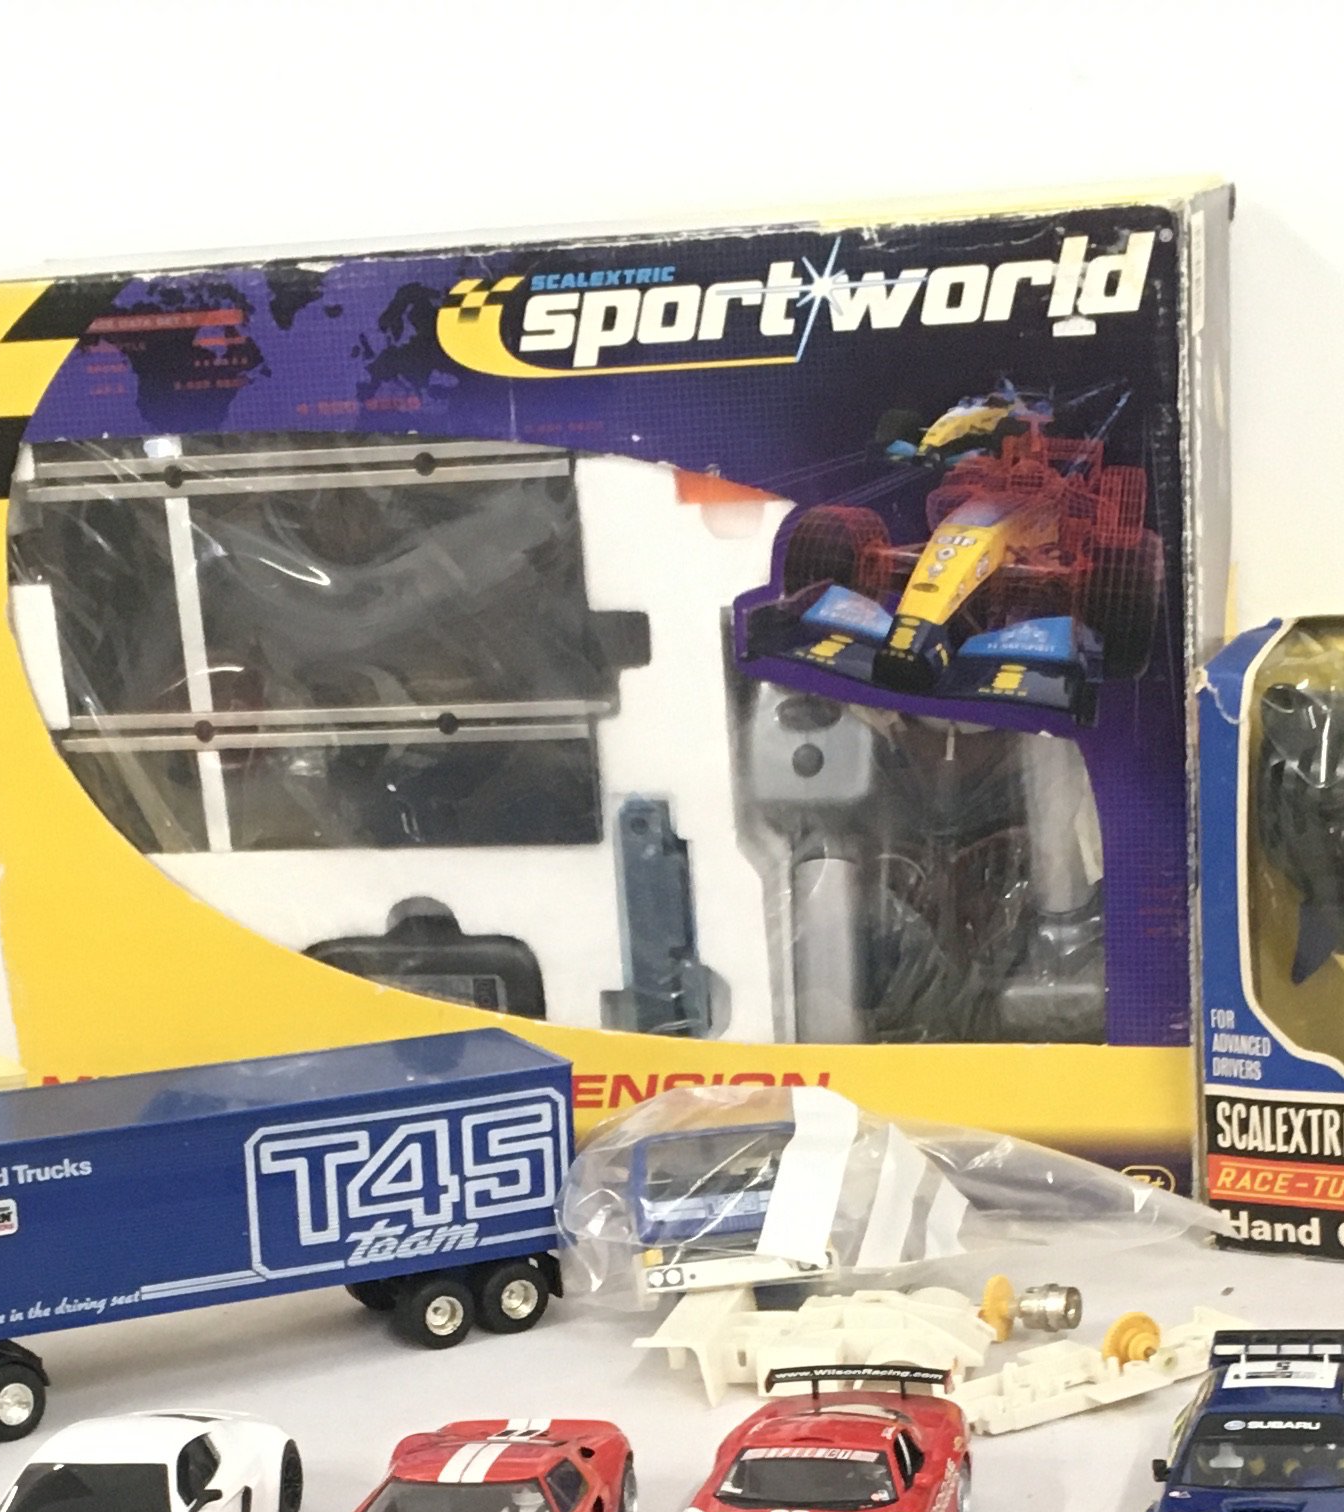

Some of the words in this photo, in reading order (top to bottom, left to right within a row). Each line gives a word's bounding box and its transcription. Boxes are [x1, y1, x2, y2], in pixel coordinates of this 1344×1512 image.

[531, 265, 676, 292] SCALEXTRIC
[1210, 1008, 1235, 1029] FOR
[1212, 1033, 1271, 1057] ADVANCED
[1212, 1057, 1262, 1081] DRIVERS
[12, 1158, 92, 1185] Trucks
[260, 1102, 555, 1246] T45
[1222, 1209, 1321, 1247] Hand
[9, 1307, 24, 1323] in
[27, 1302, 50, 1319] the
[54, 1297, 108, 1316] driving
[110, 1290, 141, 1307] seat
[1246, 1420, 1321, 1430] SUBARU
